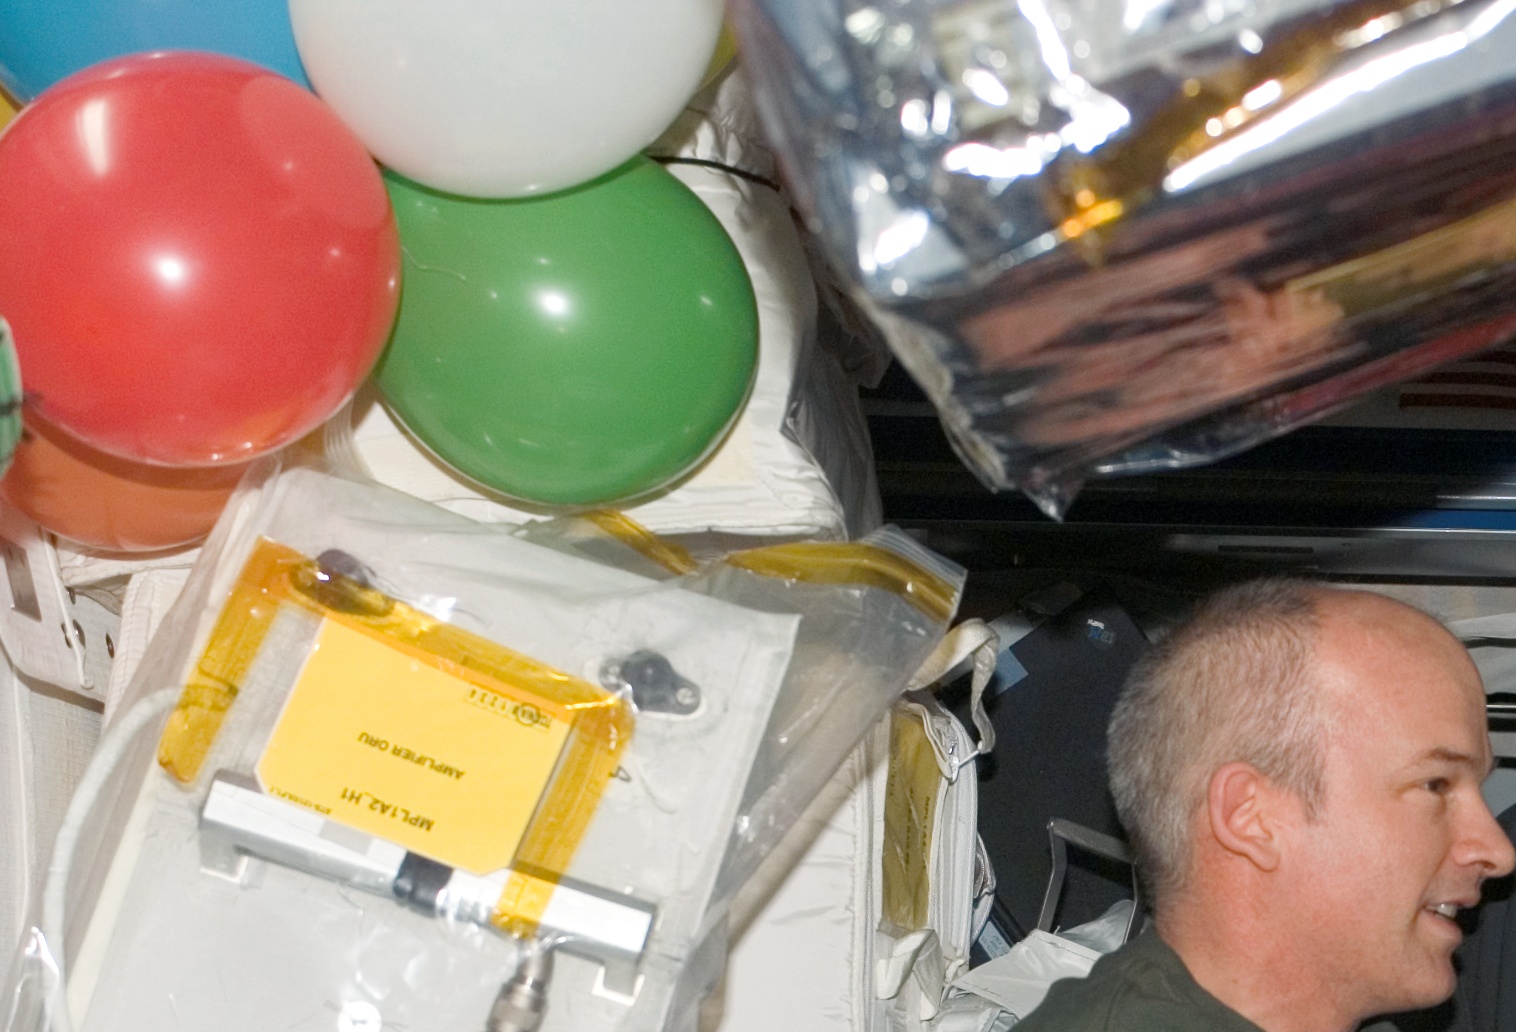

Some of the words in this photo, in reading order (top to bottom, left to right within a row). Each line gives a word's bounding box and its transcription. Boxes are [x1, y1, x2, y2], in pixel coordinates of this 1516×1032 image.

[357, 731, 390, 752] ORU
[391, 744, 466, 780] AMPLIFIER
[340, 786, 435, 832] MPL1A2_H1
